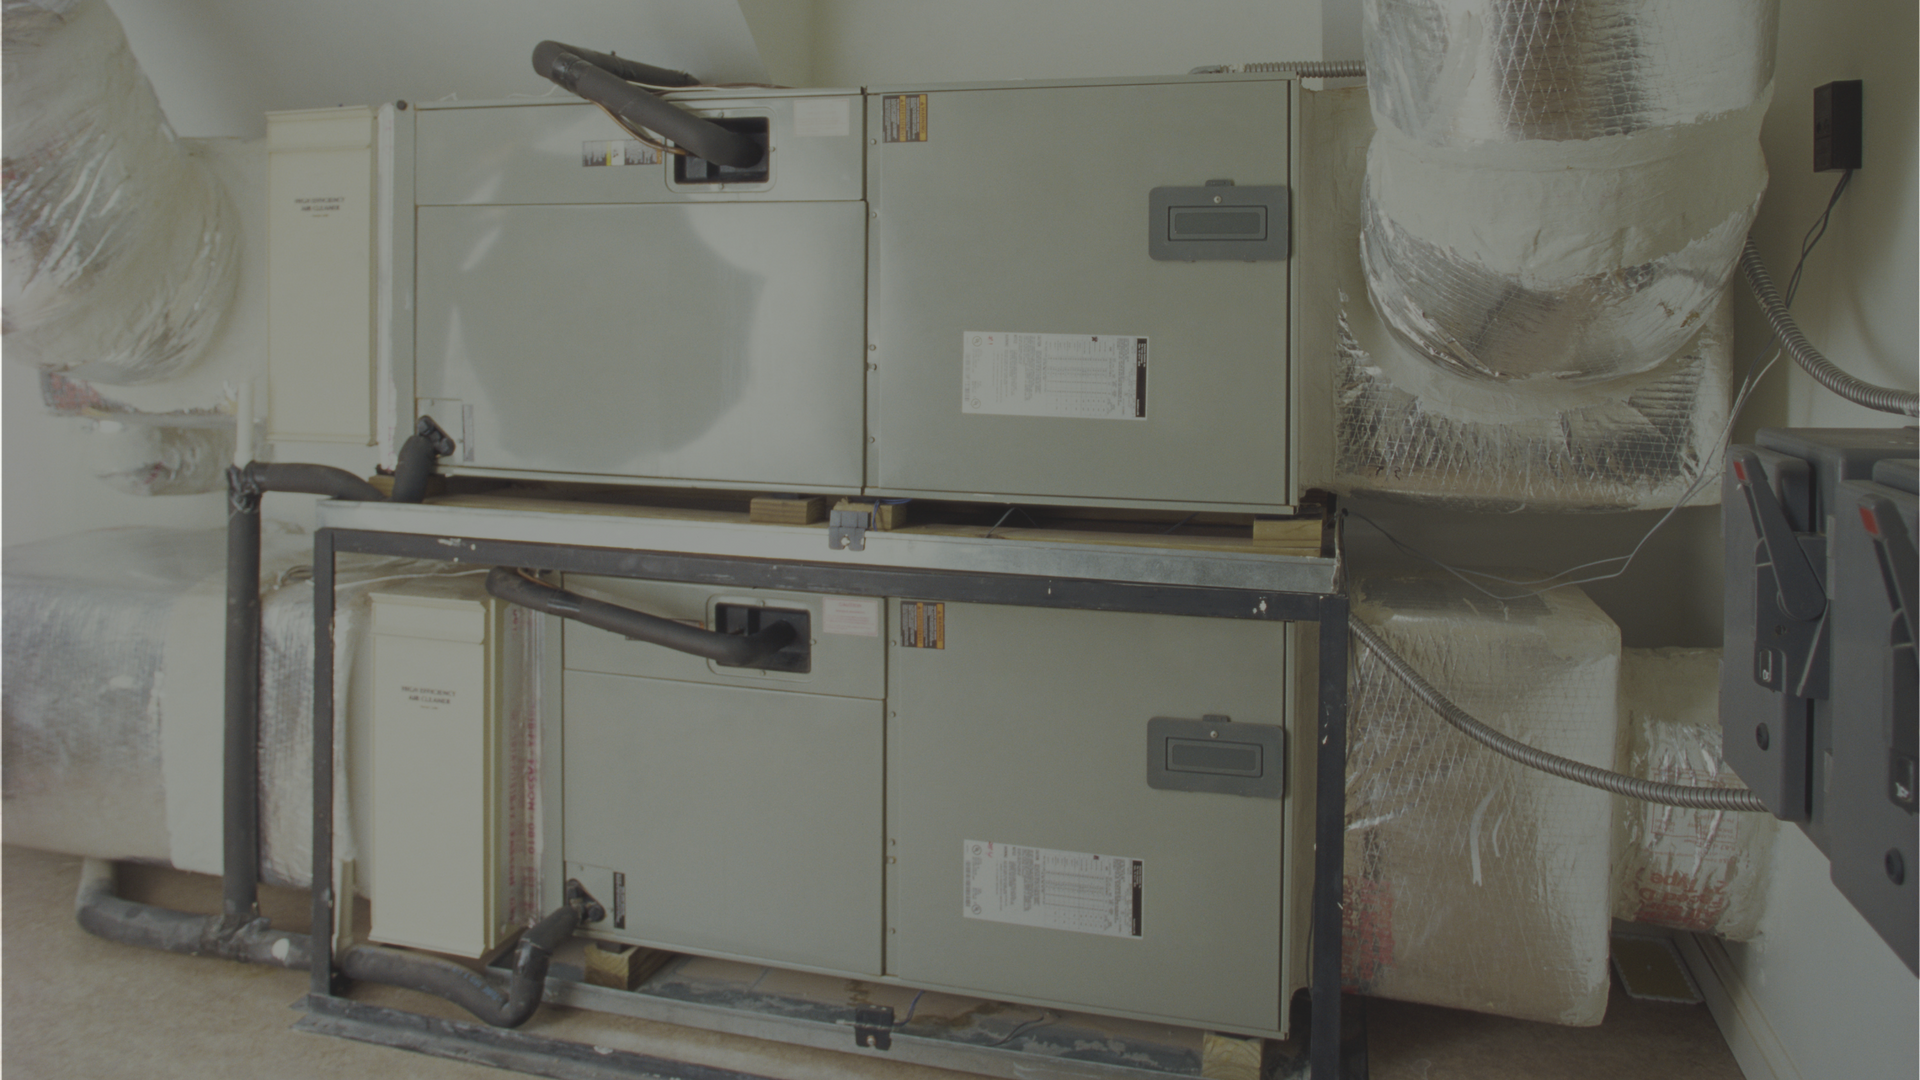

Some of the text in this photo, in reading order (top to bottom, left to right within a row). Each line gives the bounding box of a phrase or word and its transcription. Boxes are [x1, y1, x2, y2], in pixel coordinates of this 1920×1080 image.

[421, 696, 451, 704] CLEANER
[527, 758, 537, 811] FASSON
[1649, 869, 1698, 893] Type
